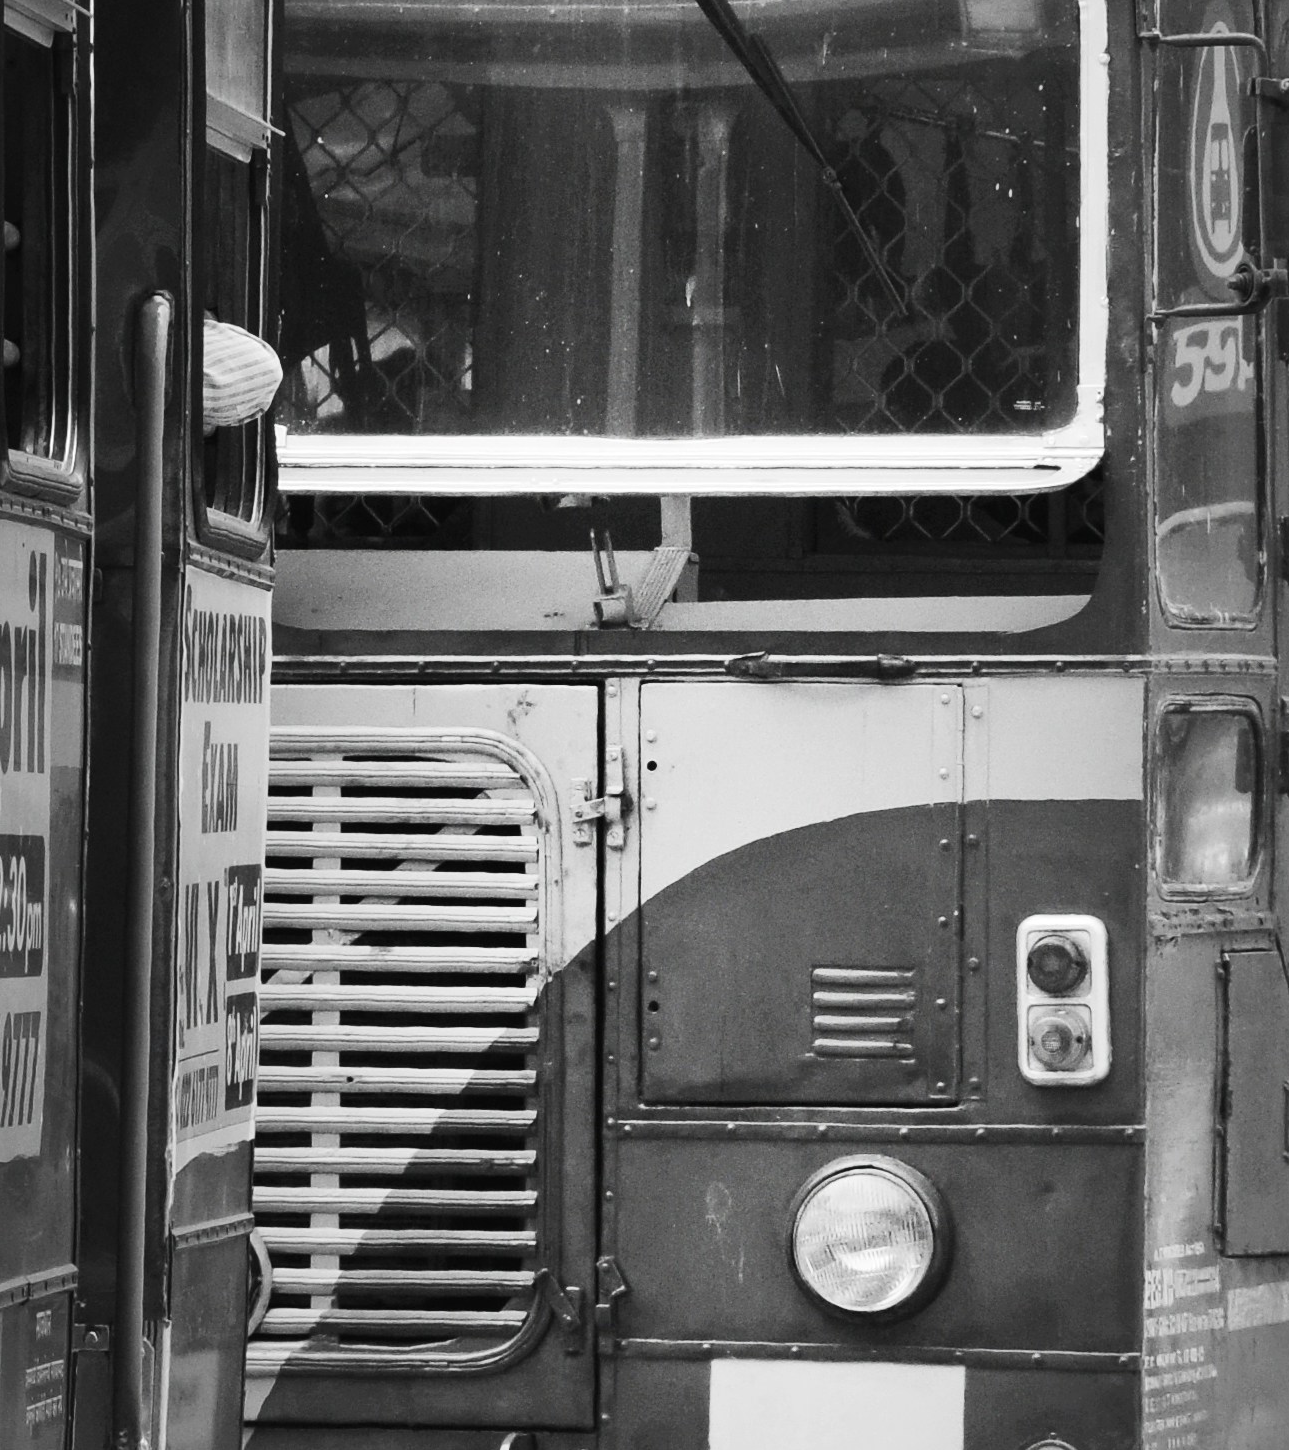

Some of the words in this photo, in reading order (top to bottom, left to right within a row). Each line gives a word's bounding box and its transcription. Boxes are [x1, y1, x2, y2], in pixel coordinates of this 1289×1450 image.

[236, 878, 261, 973] April
[0, 1010, 42, 1129] 9777
[234, 1005, 257, 1102] April
